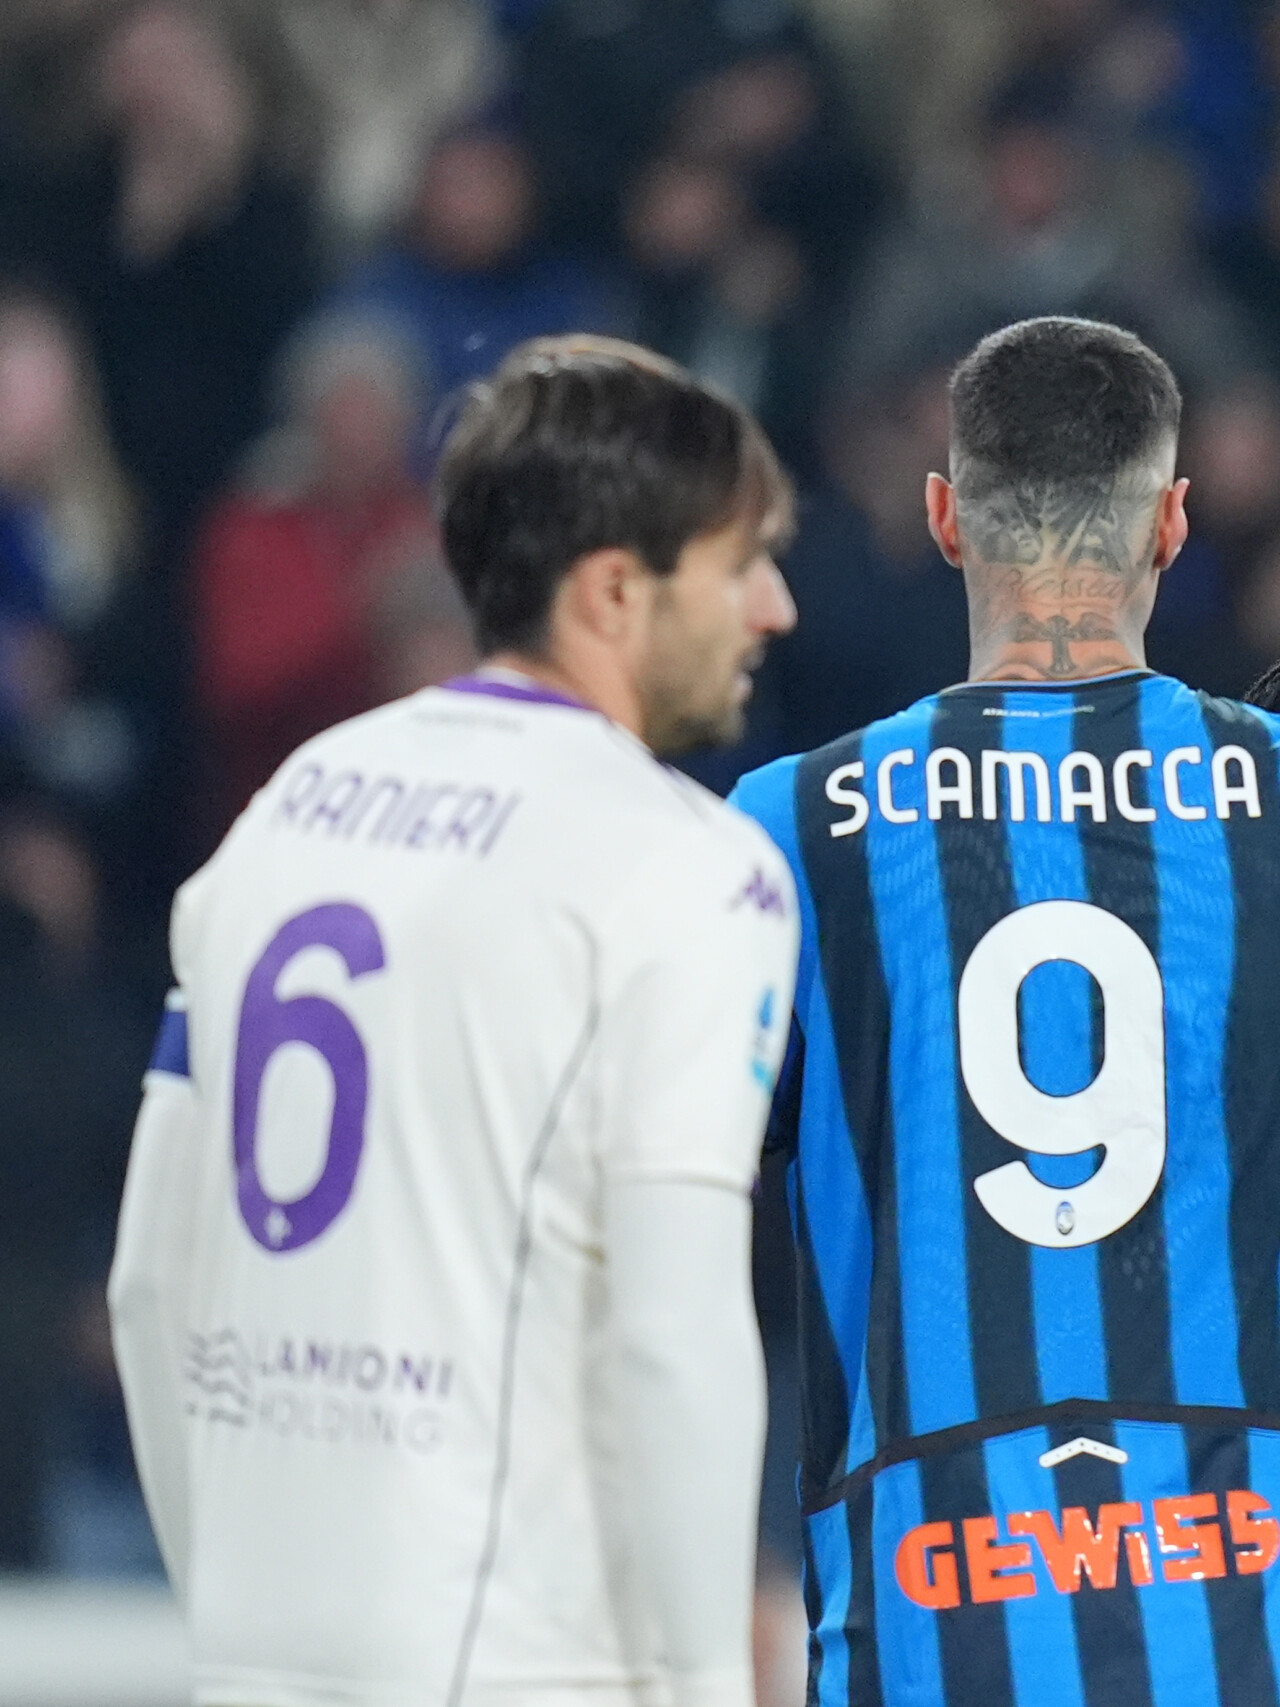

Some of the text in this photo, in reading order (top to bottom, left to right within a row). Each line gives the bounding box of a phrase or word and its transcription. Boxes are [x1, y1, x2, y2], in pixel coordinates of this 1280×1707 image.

[272, 763, 521, 857] RANIERI
[825, 745, 1261, 838] SCAMACCA
[232, 902, 386, 1253] 6
[958, 899, 1167, 1248] 9
